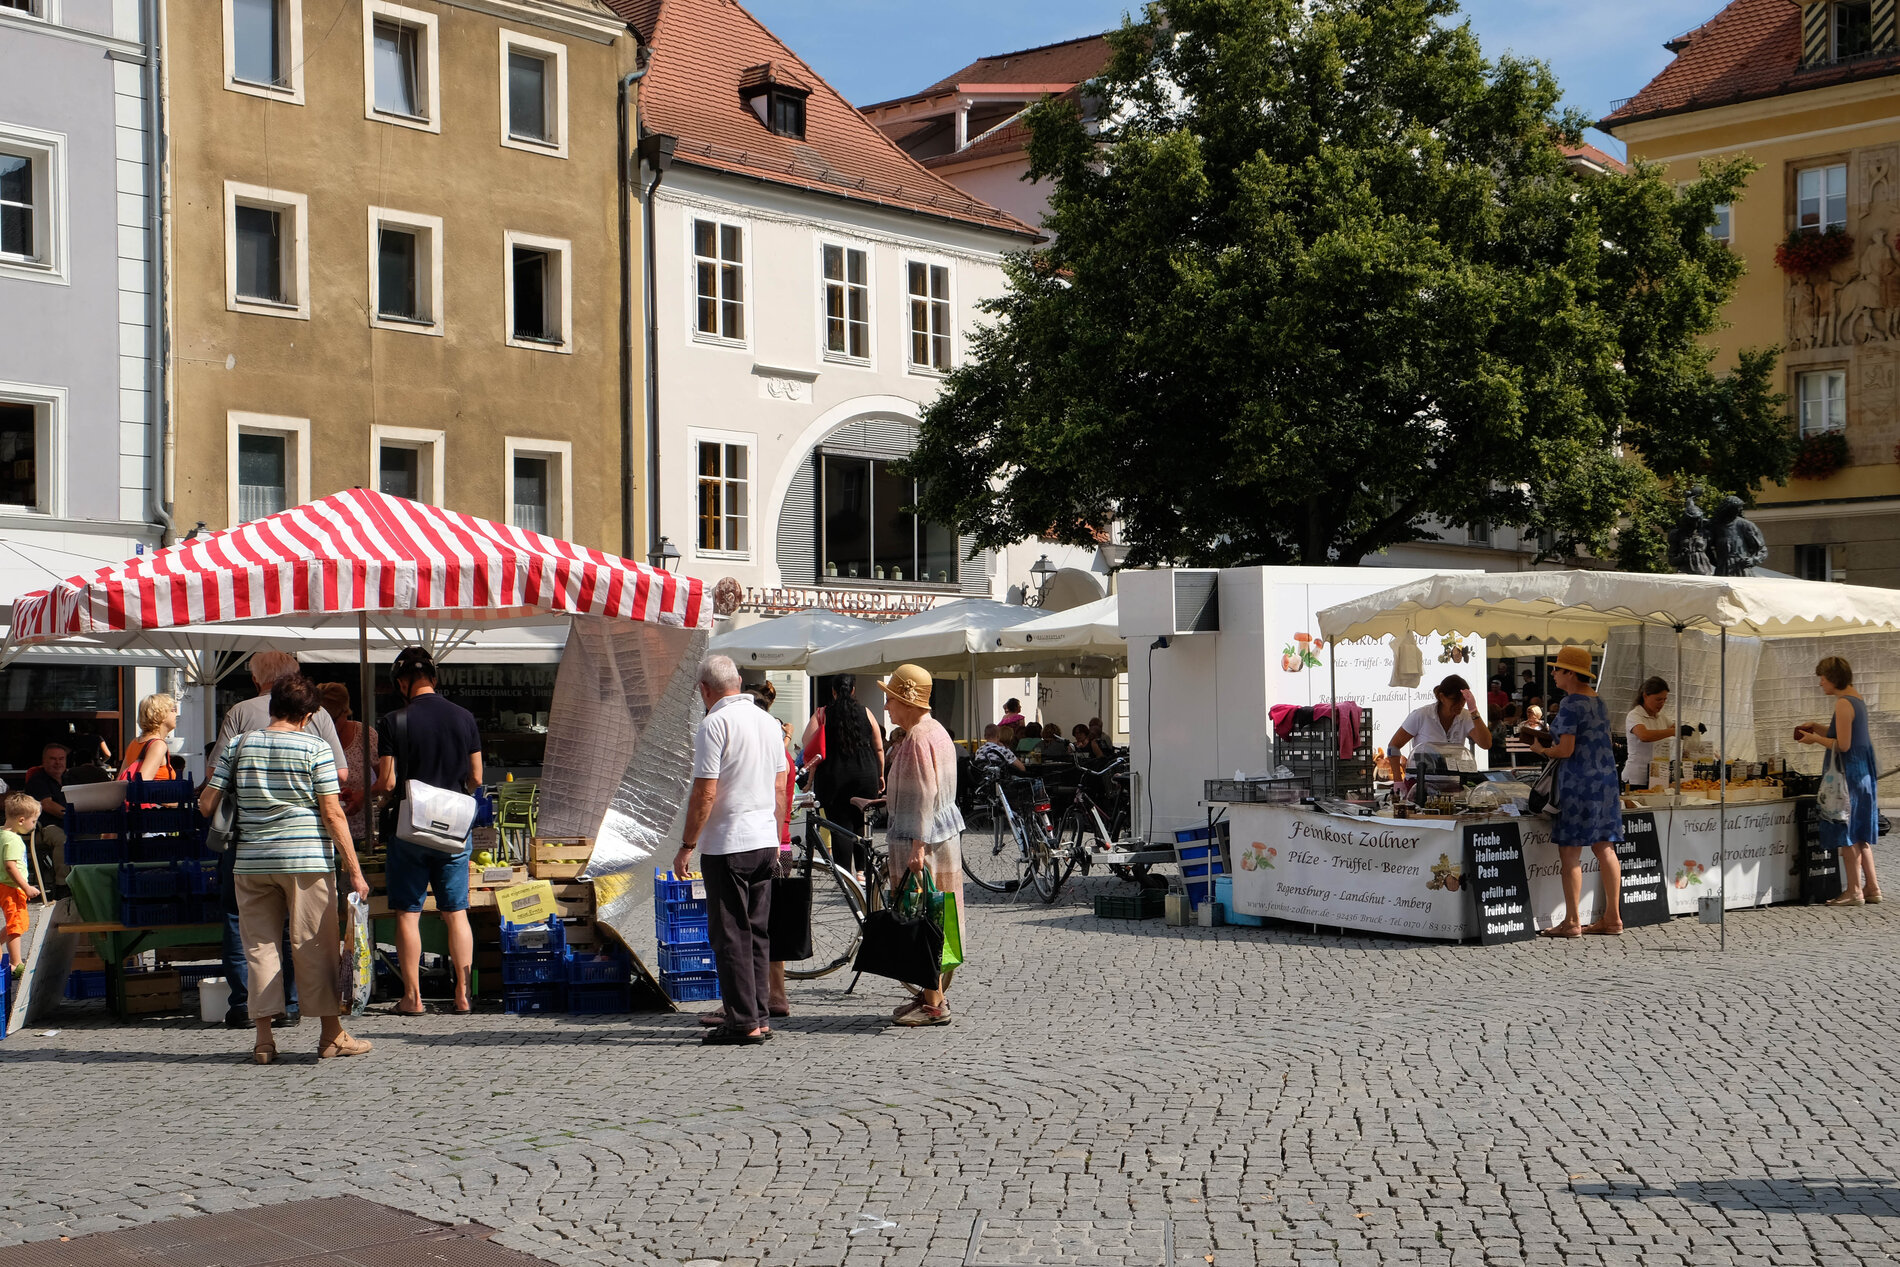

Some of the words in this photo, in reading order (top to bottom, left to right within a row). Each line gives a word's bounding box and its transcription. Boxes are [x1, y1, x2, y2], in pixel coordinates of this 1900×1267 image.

[744, 586, 936, 612] LIEBLINGSPLATZ
[1371, 691, 1407, 703] Landshut
[1627, 818, 1652, 834] Italien
[1682, 817, 1718, 836] frische
[1744, 812, 1774, 832] Trüffel
[1287, 820, 1354, 846] Feinkost
[1358, 830, 1420, 849] Zollner
[1473, 831, 1501, 847] Frische
[1475, 846, 1519, 863] italienische
[1615, 841, 1637, 855] Trüffel
[1288, 850, 1320, 866] Pilze
[1331, 855, 1372, 875] Trüffel
[1380, 861, 1420, 876] Beeren
[1619, 857, 1657, 871] Trüffelbutter
[1478, 865, 1499, 879] Pasta
[1621, 872, 1661, 888] Trüffelsalami
[1276, 881, 1331, 901] Regensburg
[1339, 890, 1386, 905] Landshut
[1393, 895, 1433, 914] Amberg
[1481, 886, 1504, 902] gefüllt
[1505, 885, 1517, 897] mit
[1623, 889, 1658, 904] Trüffelkäse
[1484, 902, 1507, 917] Trüffel
[1508, 902, 1523, 915] oder
[1360, 913, 1383, 925] Bruck
[1487, 919, 1525, 936] Steinpilzen
